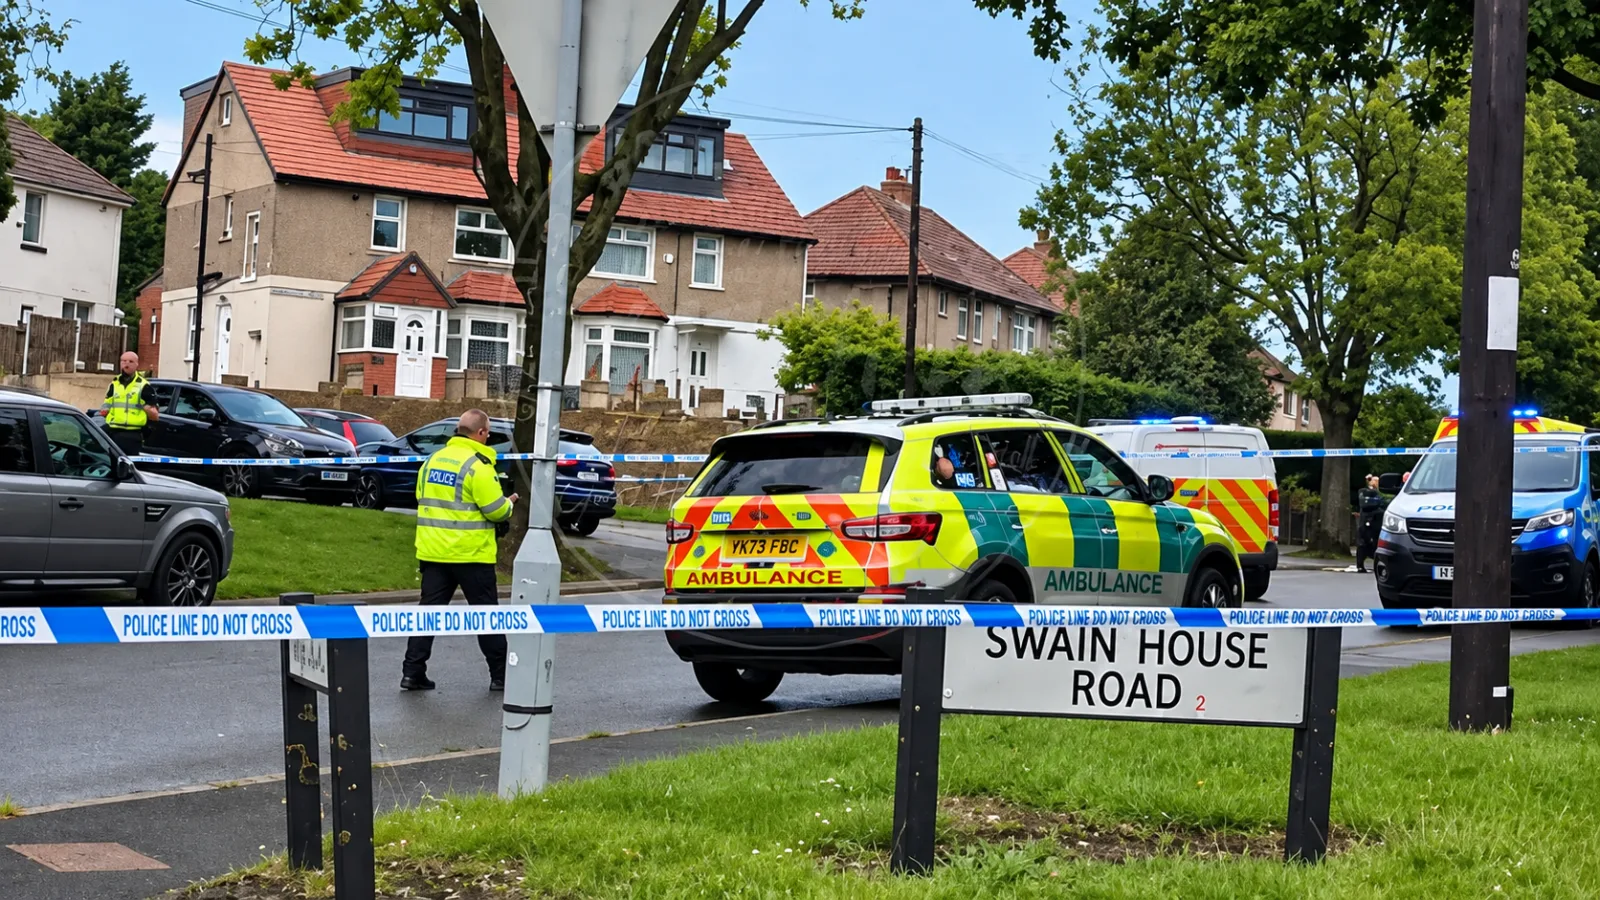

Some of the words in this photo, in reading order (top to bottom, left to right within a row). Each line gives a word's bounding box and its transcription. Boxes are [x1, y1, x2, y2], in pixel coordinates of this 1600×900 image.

[430, 470, 456, 485] POLICE
[1416, 504, 1455, 513] POL
[731, 540, 766, 555] YK73
[769, 539, 799, 554] FBC
[686, 570, 843, 586] AMBULANCE
[1043, 569, 1163, 595] AMBULANCE
[123, 614, 168, 637] POLICE
[171, 614, 199, 636] LINE
[202, 613, 220, 636] DO
[223, 613, 249, 635] NOT
[252, 613, 293, 635] CROSS
[372, 612, 413, 633] POLICE
[416, 611, 442, 632] LINE
[445, 611, 461, 632] DO
[463, 611, 487, 631] NOT
[489, 610, 529, 631] CROSS
[602, 610, 642, 629] POLICE
[643, 610, 668, 629] LINE
[671, 610, 685, 629] DO
[689, 610, 710, 628] NOT
[714, 609, 751, 628] CROSS
[819, 609, 856, 628] POLICE
[859, 609, 881, 627] LINE
[884, 609, 900, 627] DO
[902, 609, 923, 627] NOT
[925, 609, 962, 627] CROSS
[1028, 609, 1066, 627] POLICE
[1068, 609, 1091, 627] LINE
[1092, 610, 1108, 626] DO
[1109, 610, 1131, 626] NOT
[1132, 610, 1168, 626] CROSS
[1229, 610, 1266, 626] POLICE
[1266, 610, 1290, 625] LINE
[1291, 610, 1306, 625] DO
[1306, 610, 1329, 624] NOT
[1329, 610, 1365, 624] CROSS
[1425, 610, 1459, 622] POLICE
[1461, 610, 1483, 622] LINE
[1484, 610, 1499, 622] DO
[1500, 610, 1520, 621] NOT
[1522, 609, 1555, 621] CROSS
[1, 615, 36, 638] ROSS
[985, 626, 1117, 663] SWAIN
[1138, 628, 1269, 670] HOUSE
[1072, 670, 1182, 709] ROAD
[1195, 695, 1206, 711] 2
